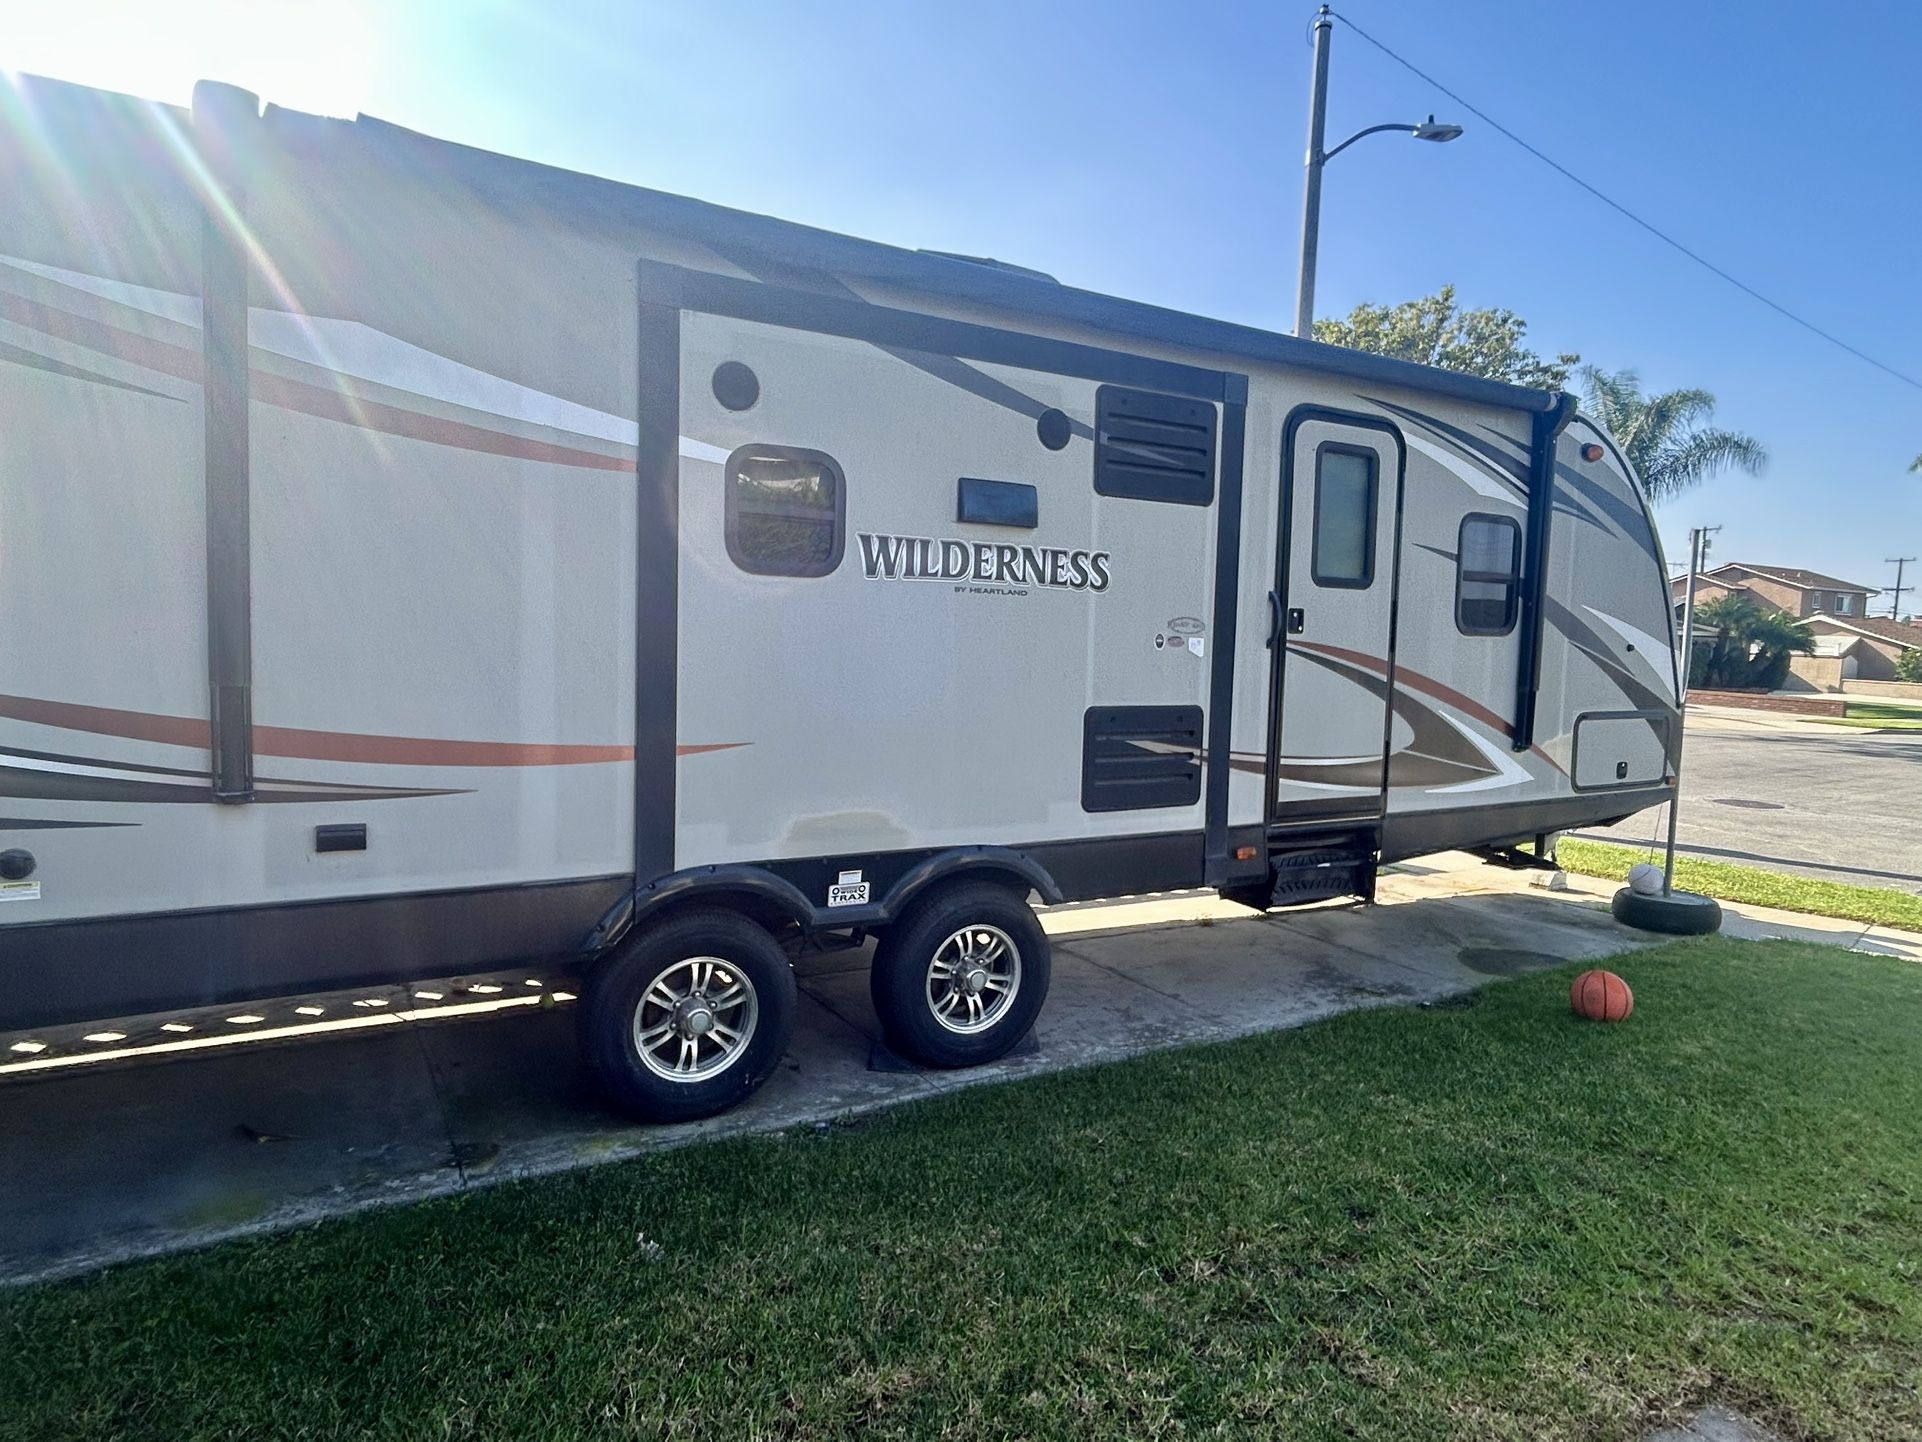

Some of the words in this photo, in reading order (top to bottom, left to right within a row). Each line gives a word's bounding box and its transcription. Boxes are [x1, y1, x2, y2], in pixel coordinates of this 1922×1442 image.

[856, 533, 1111, 593] WILDERNESS
[969, 587, 1028, 597] HEARTLAND
[831, 893, 866, 902] TRAX
